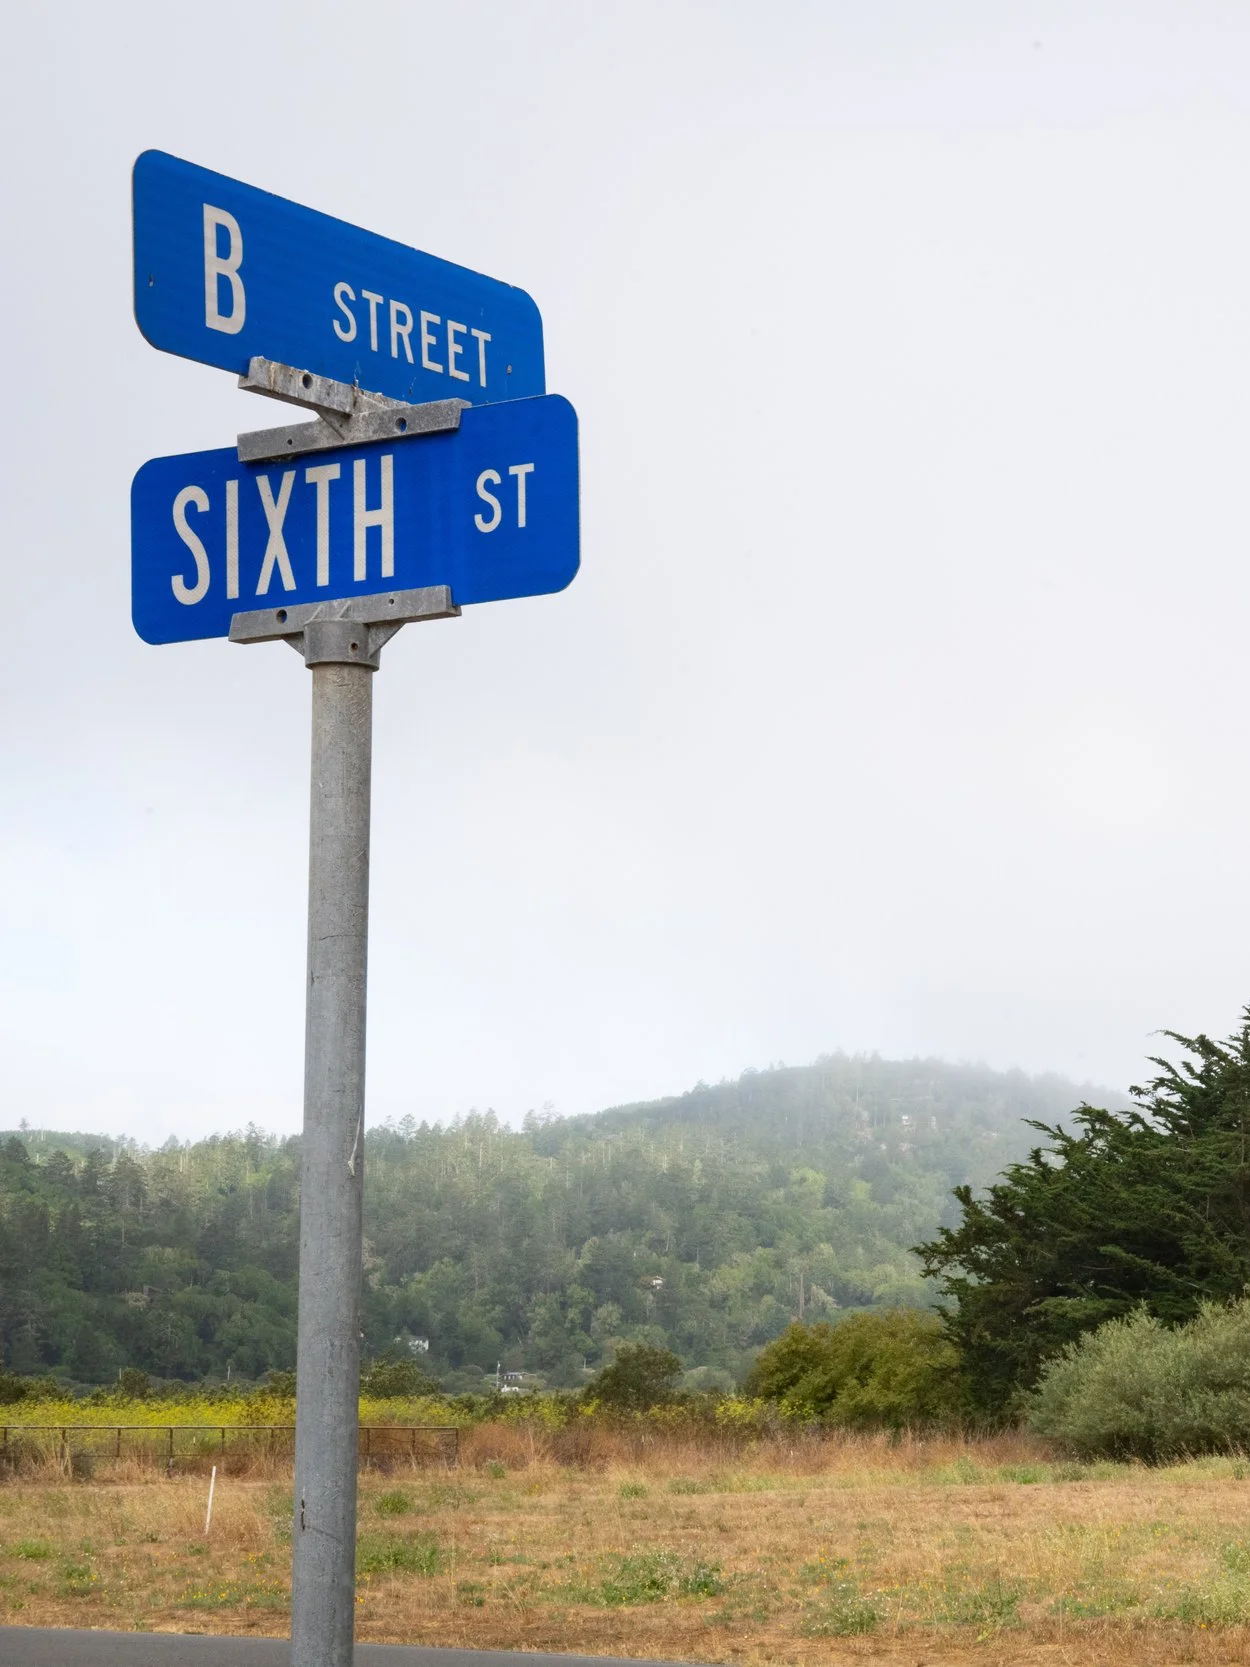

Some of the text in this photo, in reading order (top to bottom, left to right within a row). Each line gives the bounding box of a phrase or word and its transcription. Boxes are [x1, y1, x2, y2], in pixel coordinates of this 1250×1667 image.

[202, 202, 492, 388] B STREET
[170, 454, 536, 607] SIXTH ST
